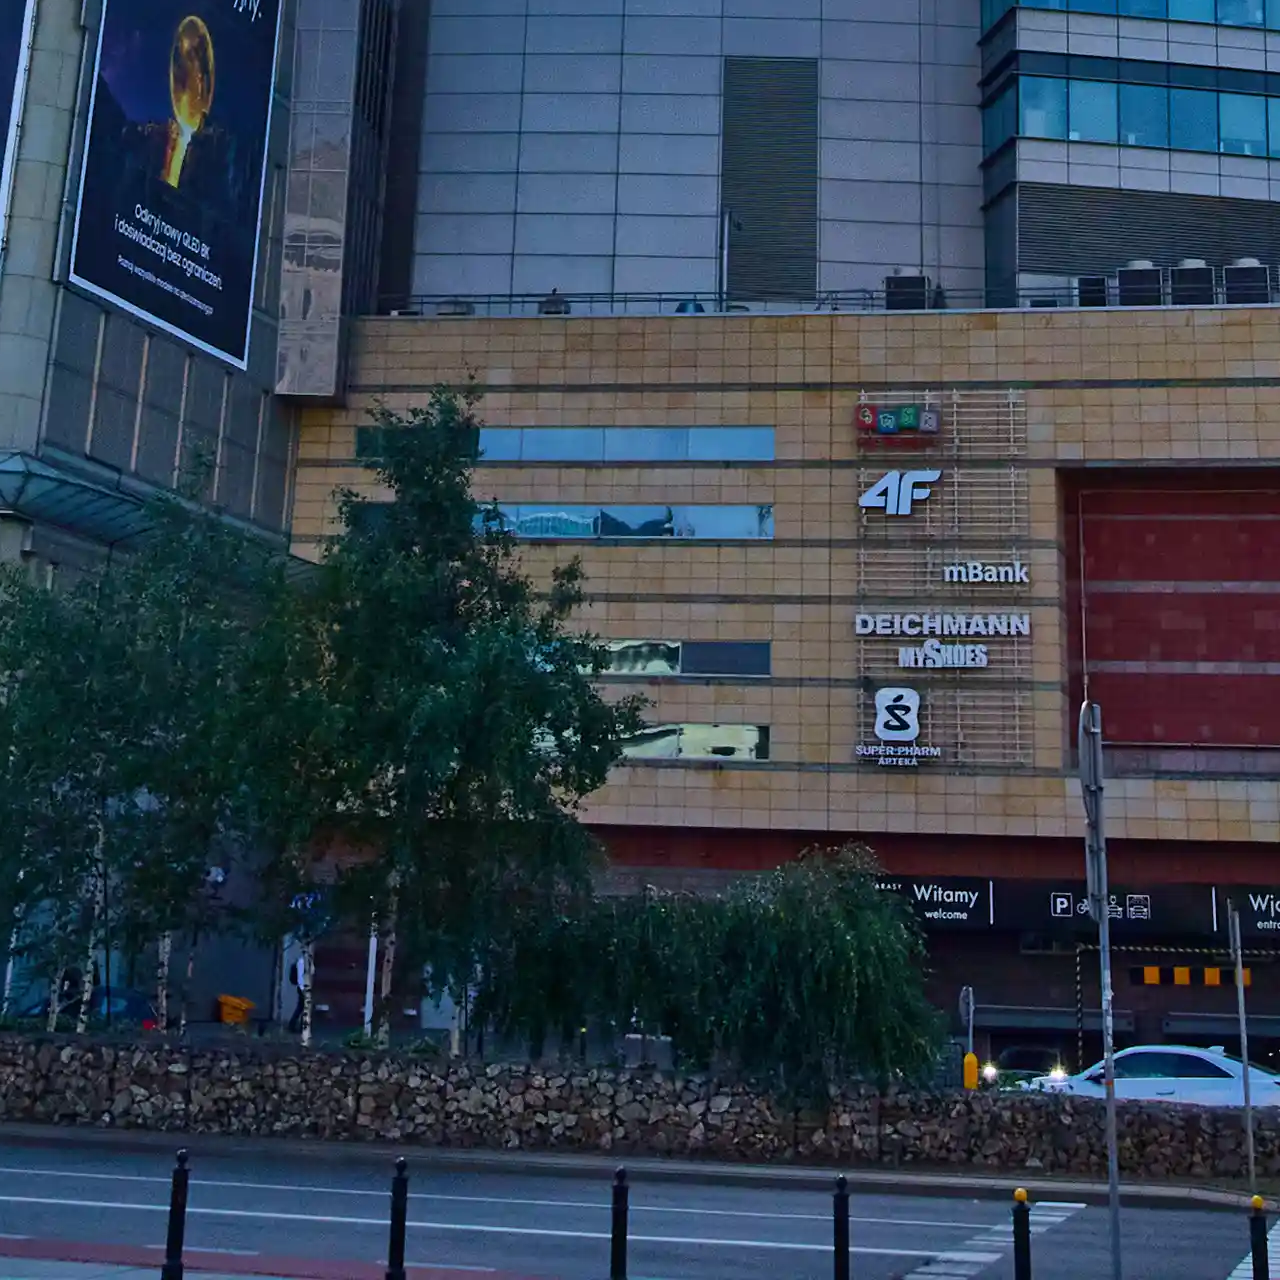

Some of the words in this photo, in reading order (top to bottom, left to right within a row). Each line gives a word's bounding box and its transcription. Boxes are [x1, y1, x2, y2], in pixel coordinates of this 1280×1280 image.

[134, 203, 162, 236] Odkryj
[160, 220, 183, 248] nowy
[182, 231, 202, 254] QLED
[200, 242, 211, 261] 8K
[118, 218, 169, 264] doświadczaj
[166, 245, 183, 267] bez
[181, 257, 223, 290] ograniczeń.
[858, 470, 944, 515] 4F
[943, 560, 1030, 583] mBank
[855, 614, 1031, 636] DEICHMANN
[855, 745, 942, 757] SUPER-PHARM
[878, 757, 919, 767] APTEKA
[913, 884, 979, 909] Witamy
[924, 907, 968, 920] welcome
